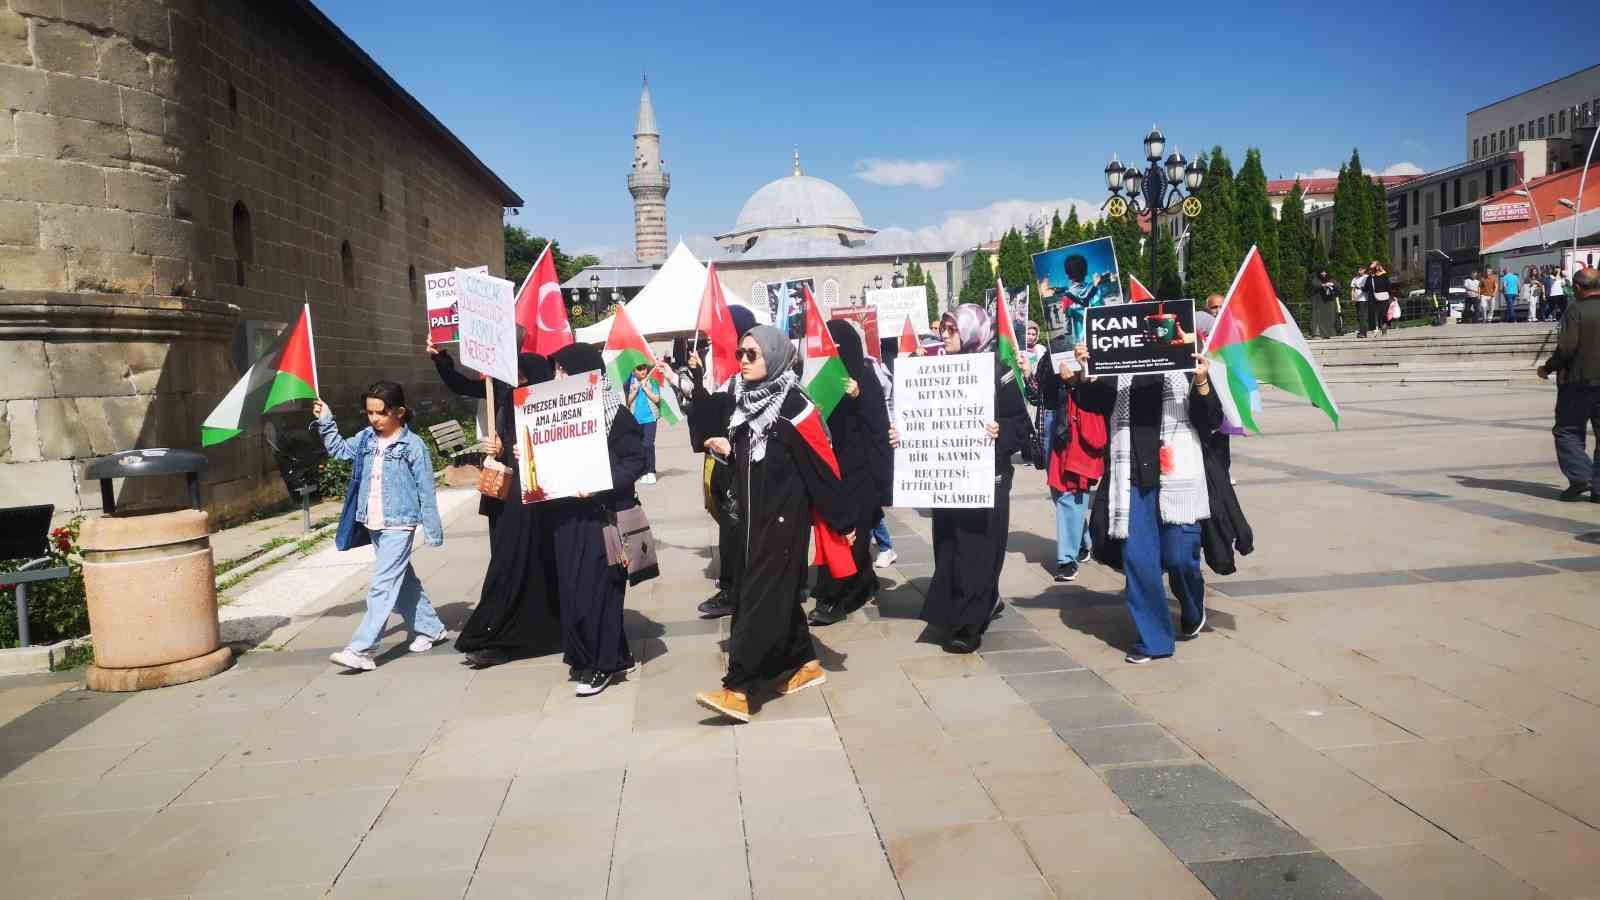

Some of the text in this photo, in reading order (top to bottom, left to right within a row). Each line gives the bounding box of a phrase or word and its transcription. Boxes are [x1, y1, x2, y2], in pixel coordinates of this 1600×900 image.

[431, 313, 459, 328] PALE
[1091, 315, 1138, 332] KAN
[1092, 333, 1145, 352] İÇME
[523, 397, 558, 415] YEMEZSEN
[535, 407, 582, 427] AMA ALIRSAN
[532, 418, 598, 446] ÖLDÜRÜRLER!
